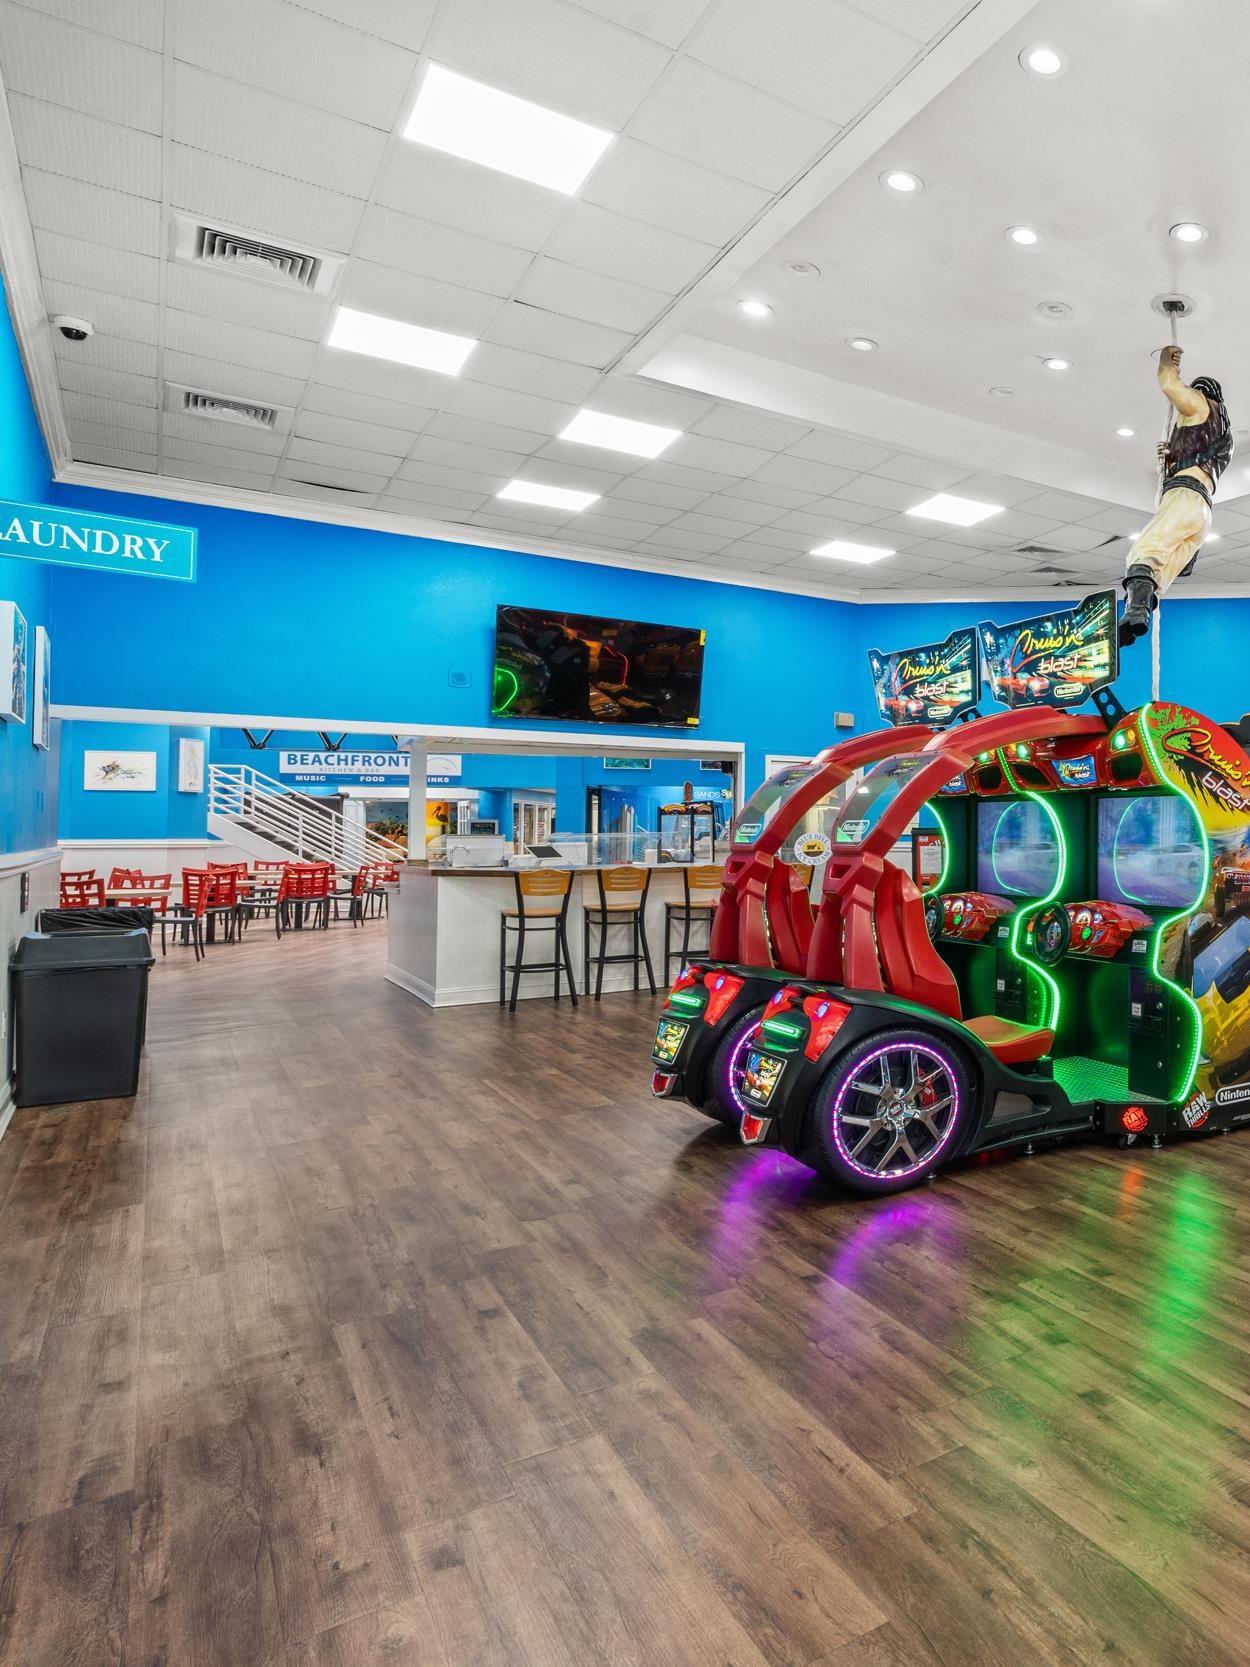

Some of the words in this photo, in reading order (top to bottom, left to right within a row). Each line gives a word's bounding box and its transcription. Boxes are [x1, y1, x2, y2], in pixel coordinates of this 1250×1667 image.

[0, 517, 170, 562] AUNDRY
[1038, 653, 1081, 675] blast
[914, 680, 949, 697] blast
[287, 753, 410, 767] BEACHFRONT
[1202, 771, 1250, 810] blast
[1122, 1107, 1145, 1124] RAW
[1182, 1091, 1207, 1121] RAW
[1187, 1102, 1211, 1128] THRILLS
